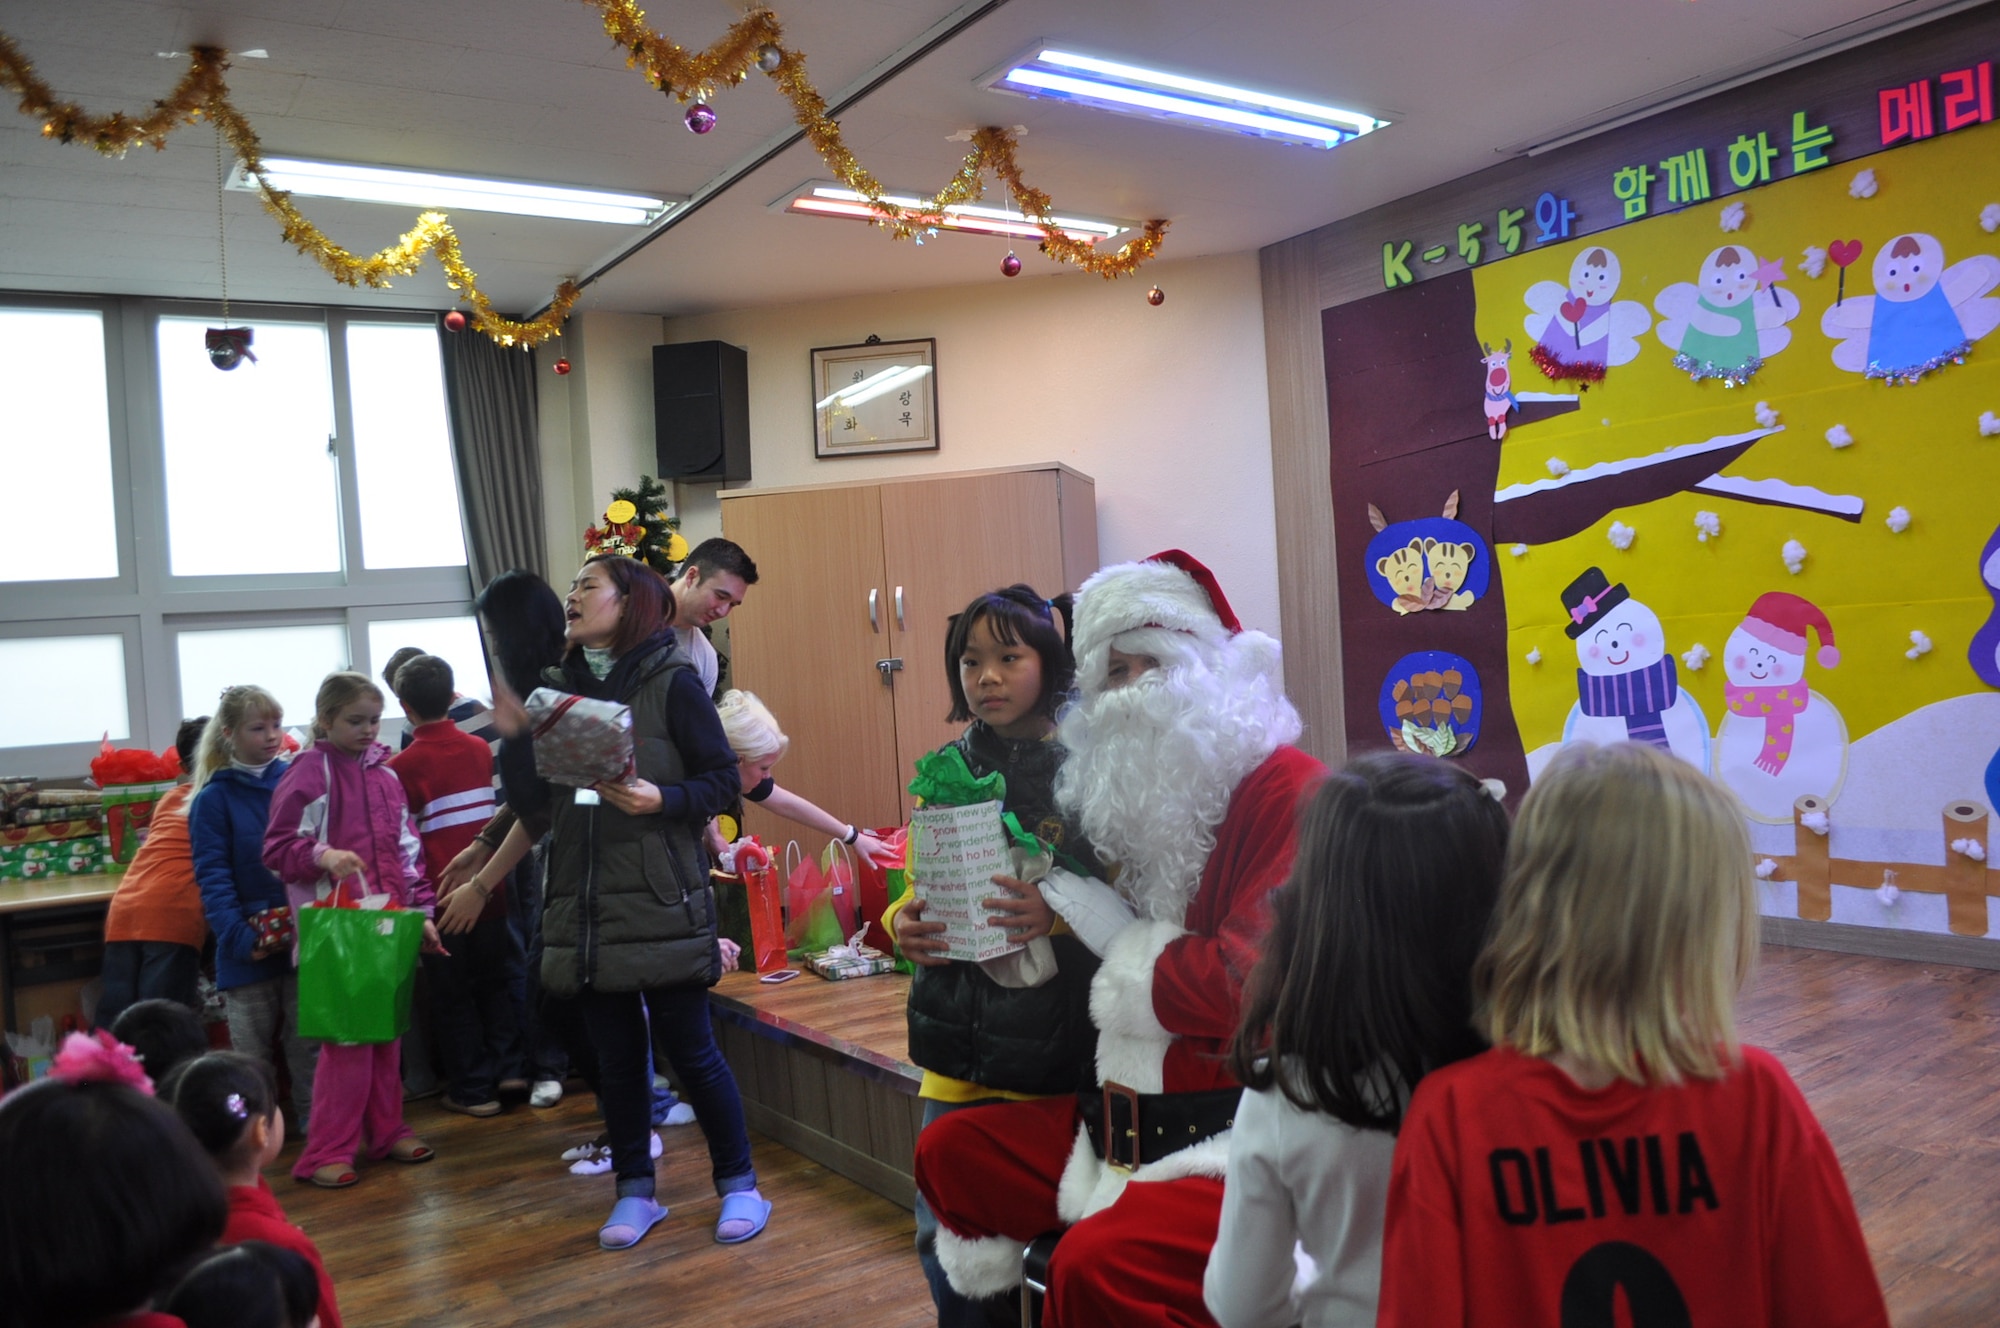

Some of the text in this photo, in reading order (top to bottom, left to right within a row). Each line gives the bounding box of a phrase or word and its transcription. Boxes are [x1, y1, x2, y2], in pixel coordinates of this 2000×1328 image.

[1878, 60, 1993, 146] 메리
[922, 812, 954, 824] happy
[956, 808, 979, 819] new
[952, 852, 963, 863] ho
[966, 850, 981, 861] ho
[983, 847, 996, 858] ho
[976, 861, 1002, 873] snow
[979, 931, 1004, 948] jingle
[978, 946, 1005, 958] warm
[1489, 1131, 1719, 1226] OLIVIA
